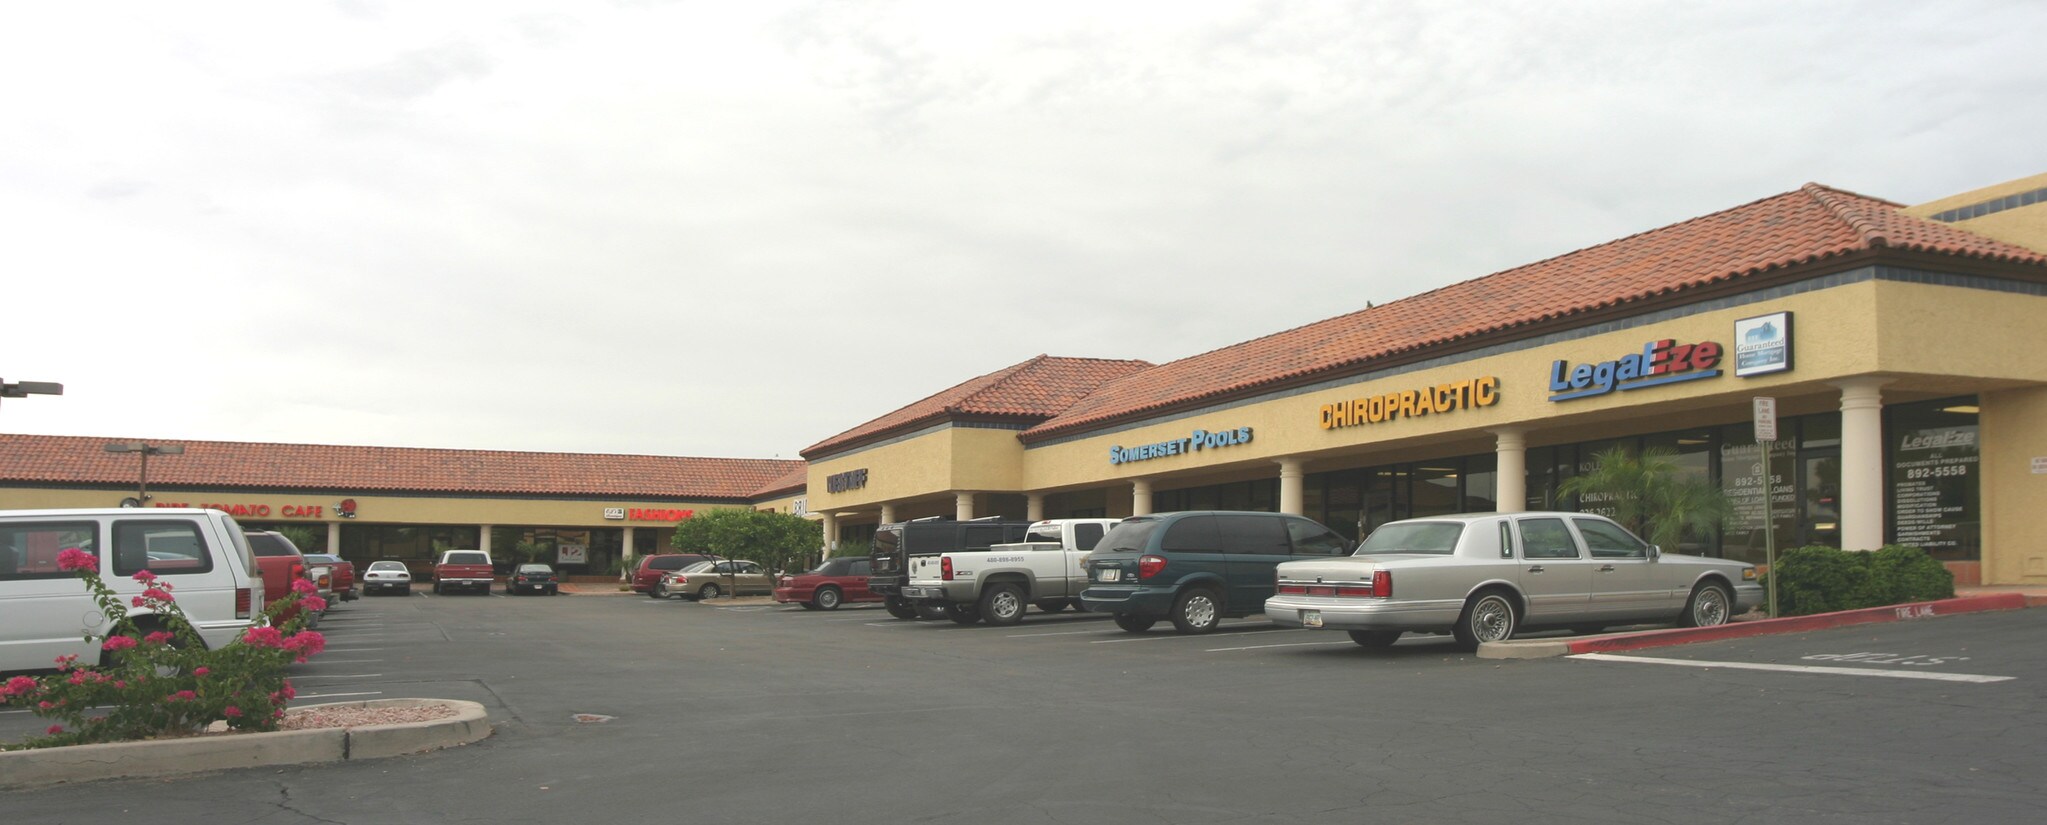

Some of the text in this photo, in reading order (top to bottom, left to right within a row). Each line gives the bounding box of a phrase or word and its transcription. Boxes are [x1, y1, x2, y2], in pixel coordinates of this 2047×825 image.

[1737, 337, 1784, 352] Guaranteed
[1320, 376, 1498, 429] CHIROPRACTIC
[1896, 456, 1979, 468] DOCUMENTS PREPARED
[1907, 465, 1966, 479] 892-5558
[281, 504, 323, 518] CAFE
[1896, 605, 1934, 619] FIRE LANE
